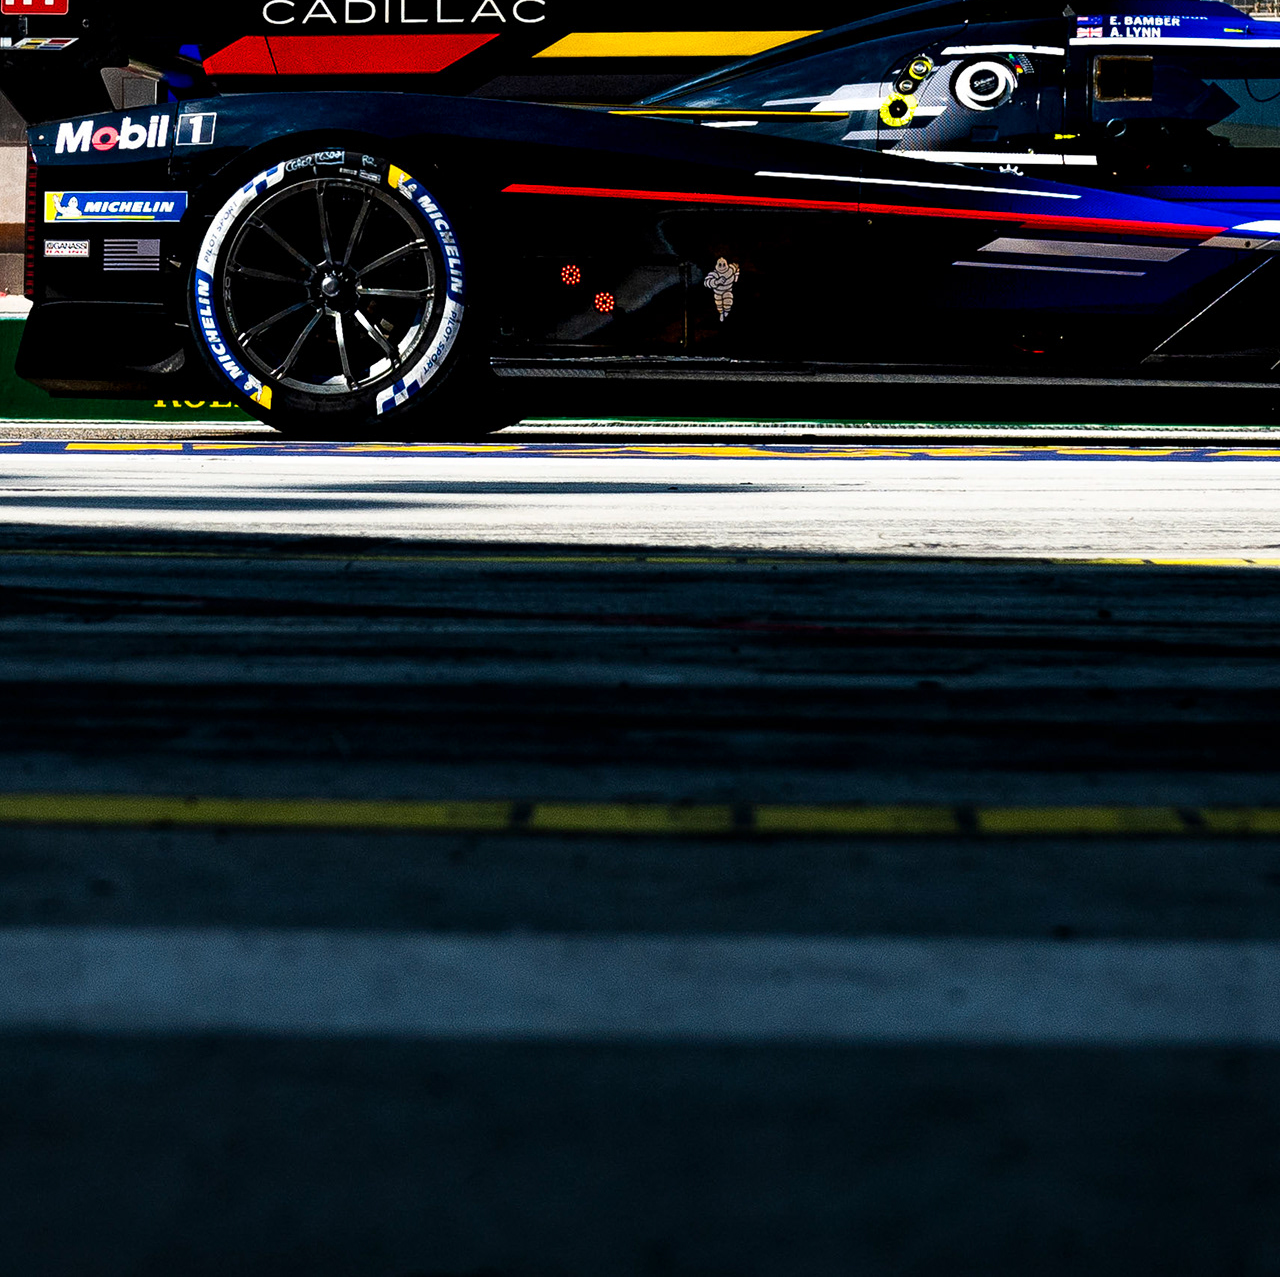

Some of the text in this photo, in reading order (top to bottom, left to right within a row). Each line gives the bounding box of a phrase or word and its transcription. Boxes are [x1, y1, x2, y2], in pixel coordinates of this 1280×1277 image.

[1109, 15, 1122, 26] E.
[1123, 15, 1181, 27] BAMBER
[1109, 26, 1162, 38] A. LYNN
[54, 114, 204, 155] Mobil 1
[83, 201, 175, 213] MICHELIN
[415, 194, 464, 295] MICHELIN
[196, 278, 246, 383] MICHELIN
[423, 310, 458, 375] PILOT SPORT
